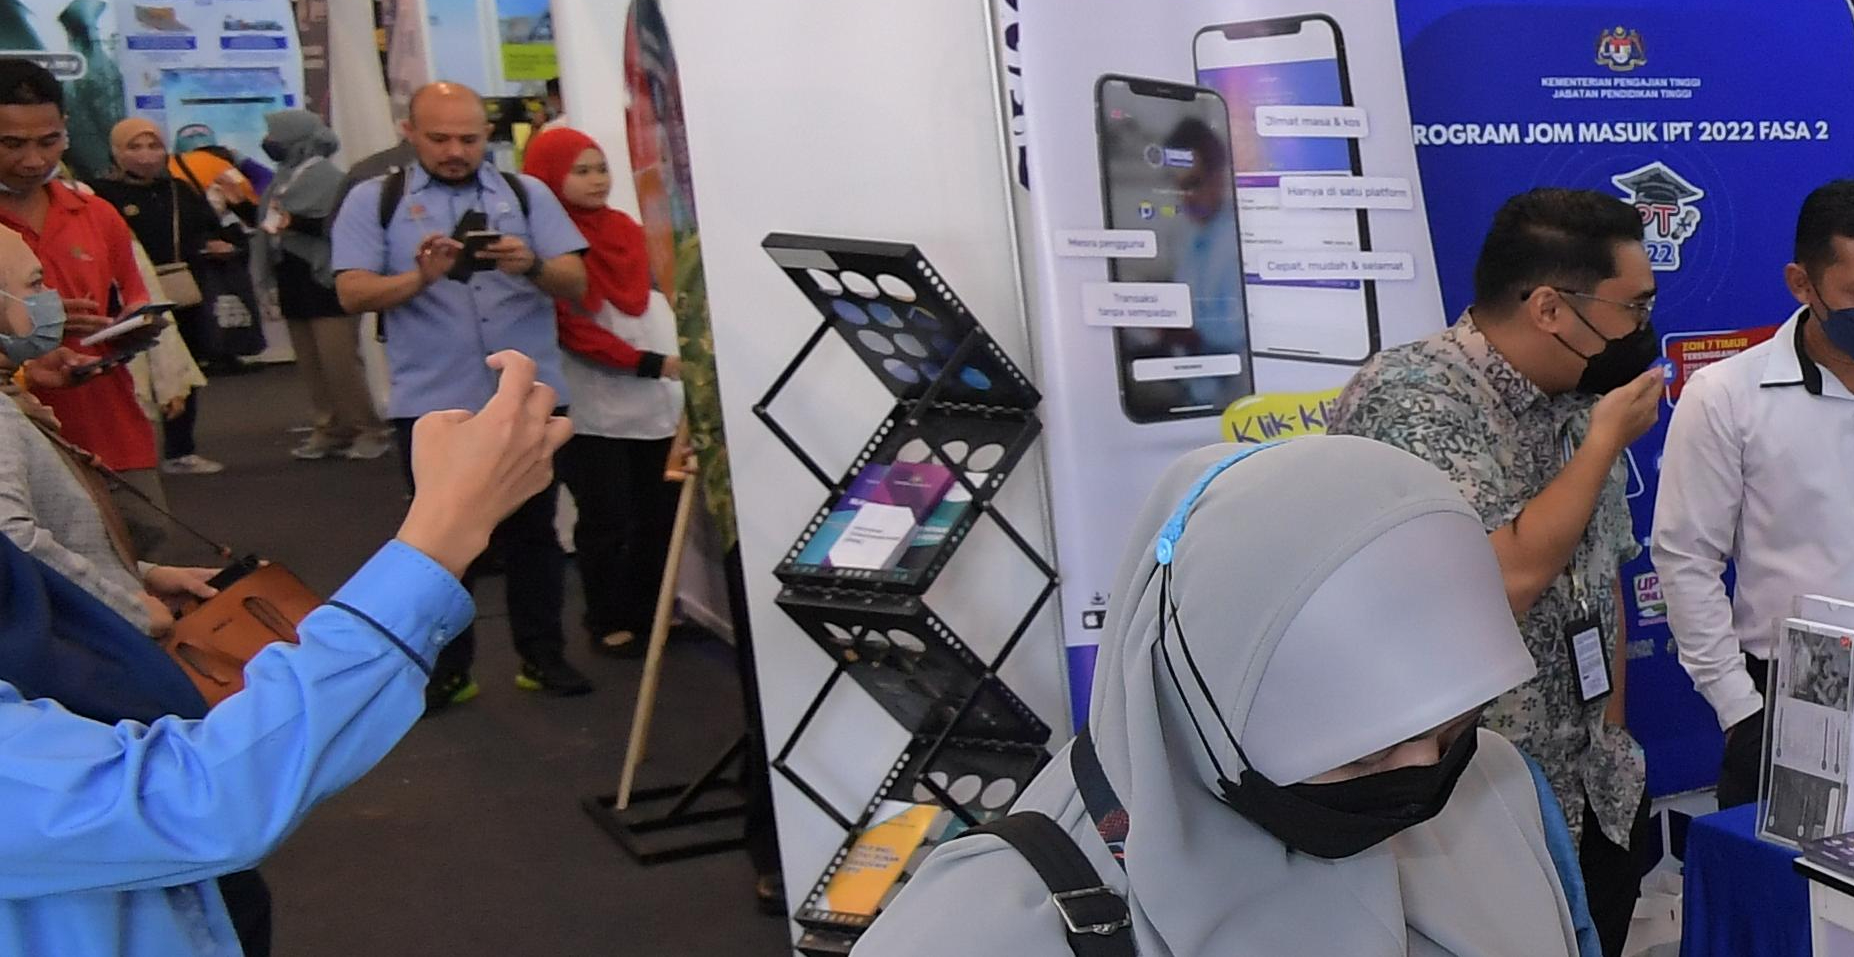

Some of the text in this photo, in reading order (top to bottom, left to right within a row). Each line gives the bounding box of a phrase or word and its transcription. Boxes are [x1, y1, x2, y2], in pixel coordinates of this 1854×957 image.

[1414, 121, 1829, 145] ROGRAM JOM MASUK IPT 2022 FASA 2
[1637, 575, 1659, 592] UP
